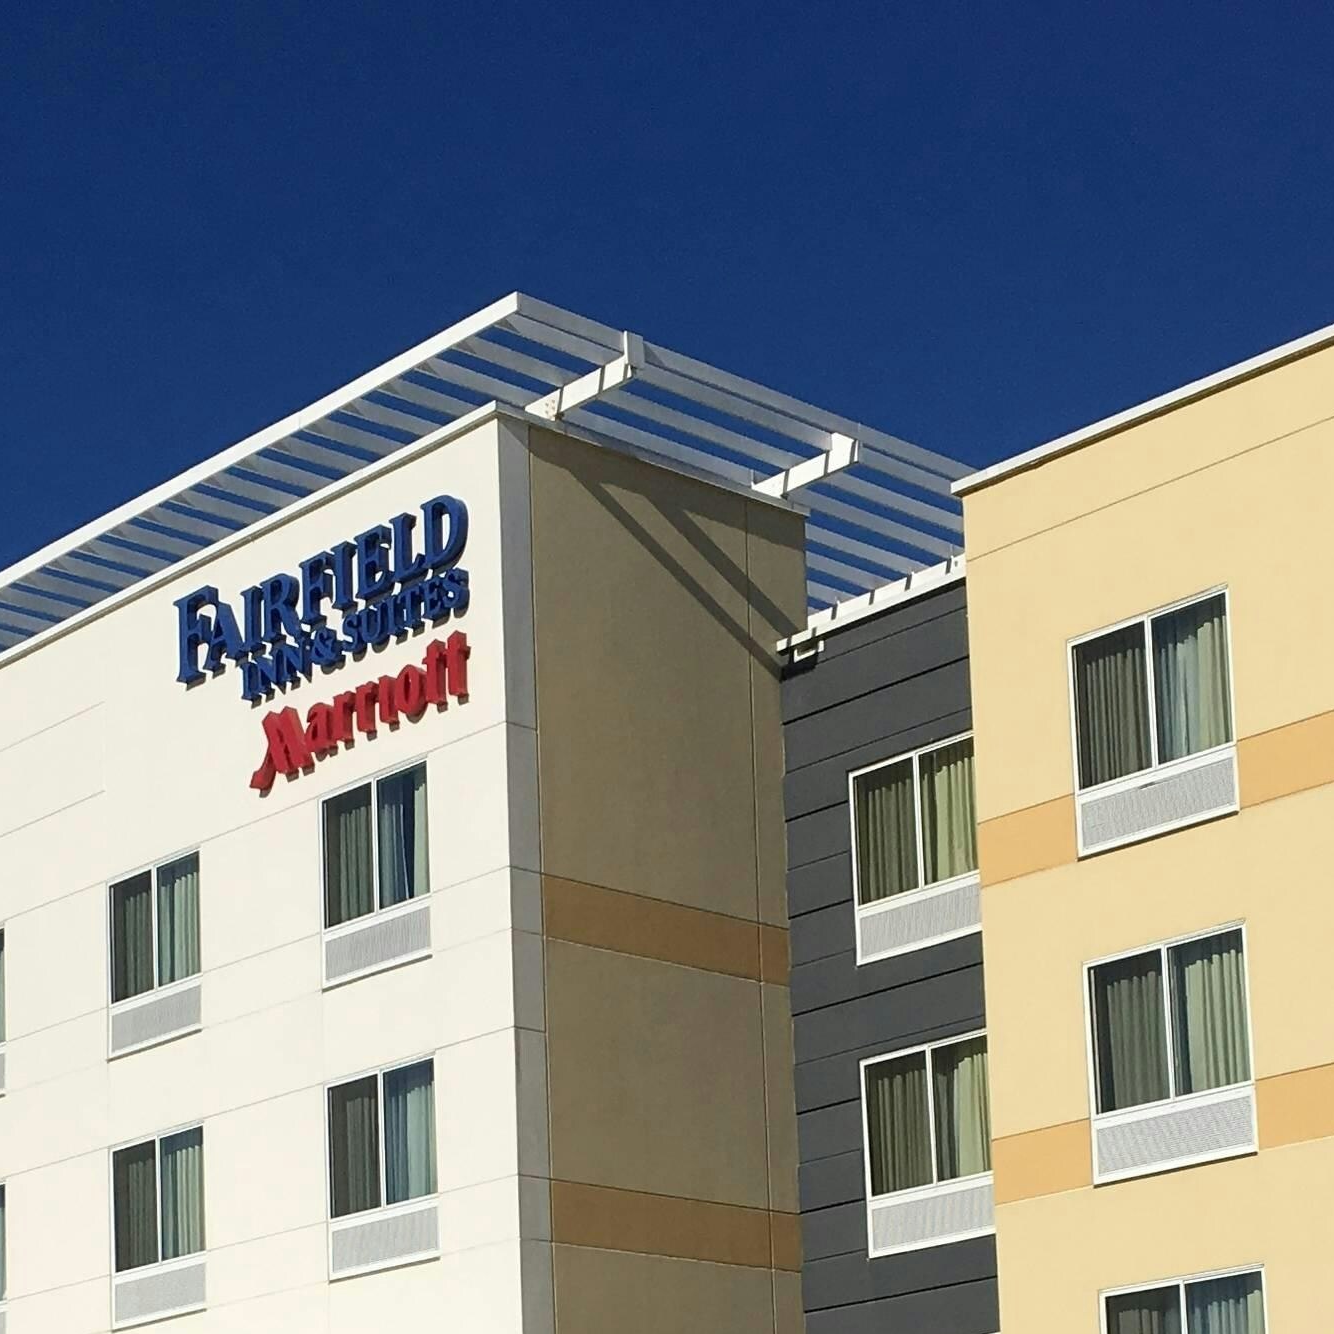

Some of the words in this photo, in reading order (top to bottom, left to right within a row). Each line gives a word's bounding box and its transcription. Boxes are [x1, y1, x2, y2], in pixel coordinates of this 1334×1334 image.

[173, 494, 469, 690] FAIRFIELD
[240, 634, 313, 708] INN
[311, 625, 346, 675] &
[341, 566, 471, 662] SUITES
[249, 629, 472, 798] Marriott
